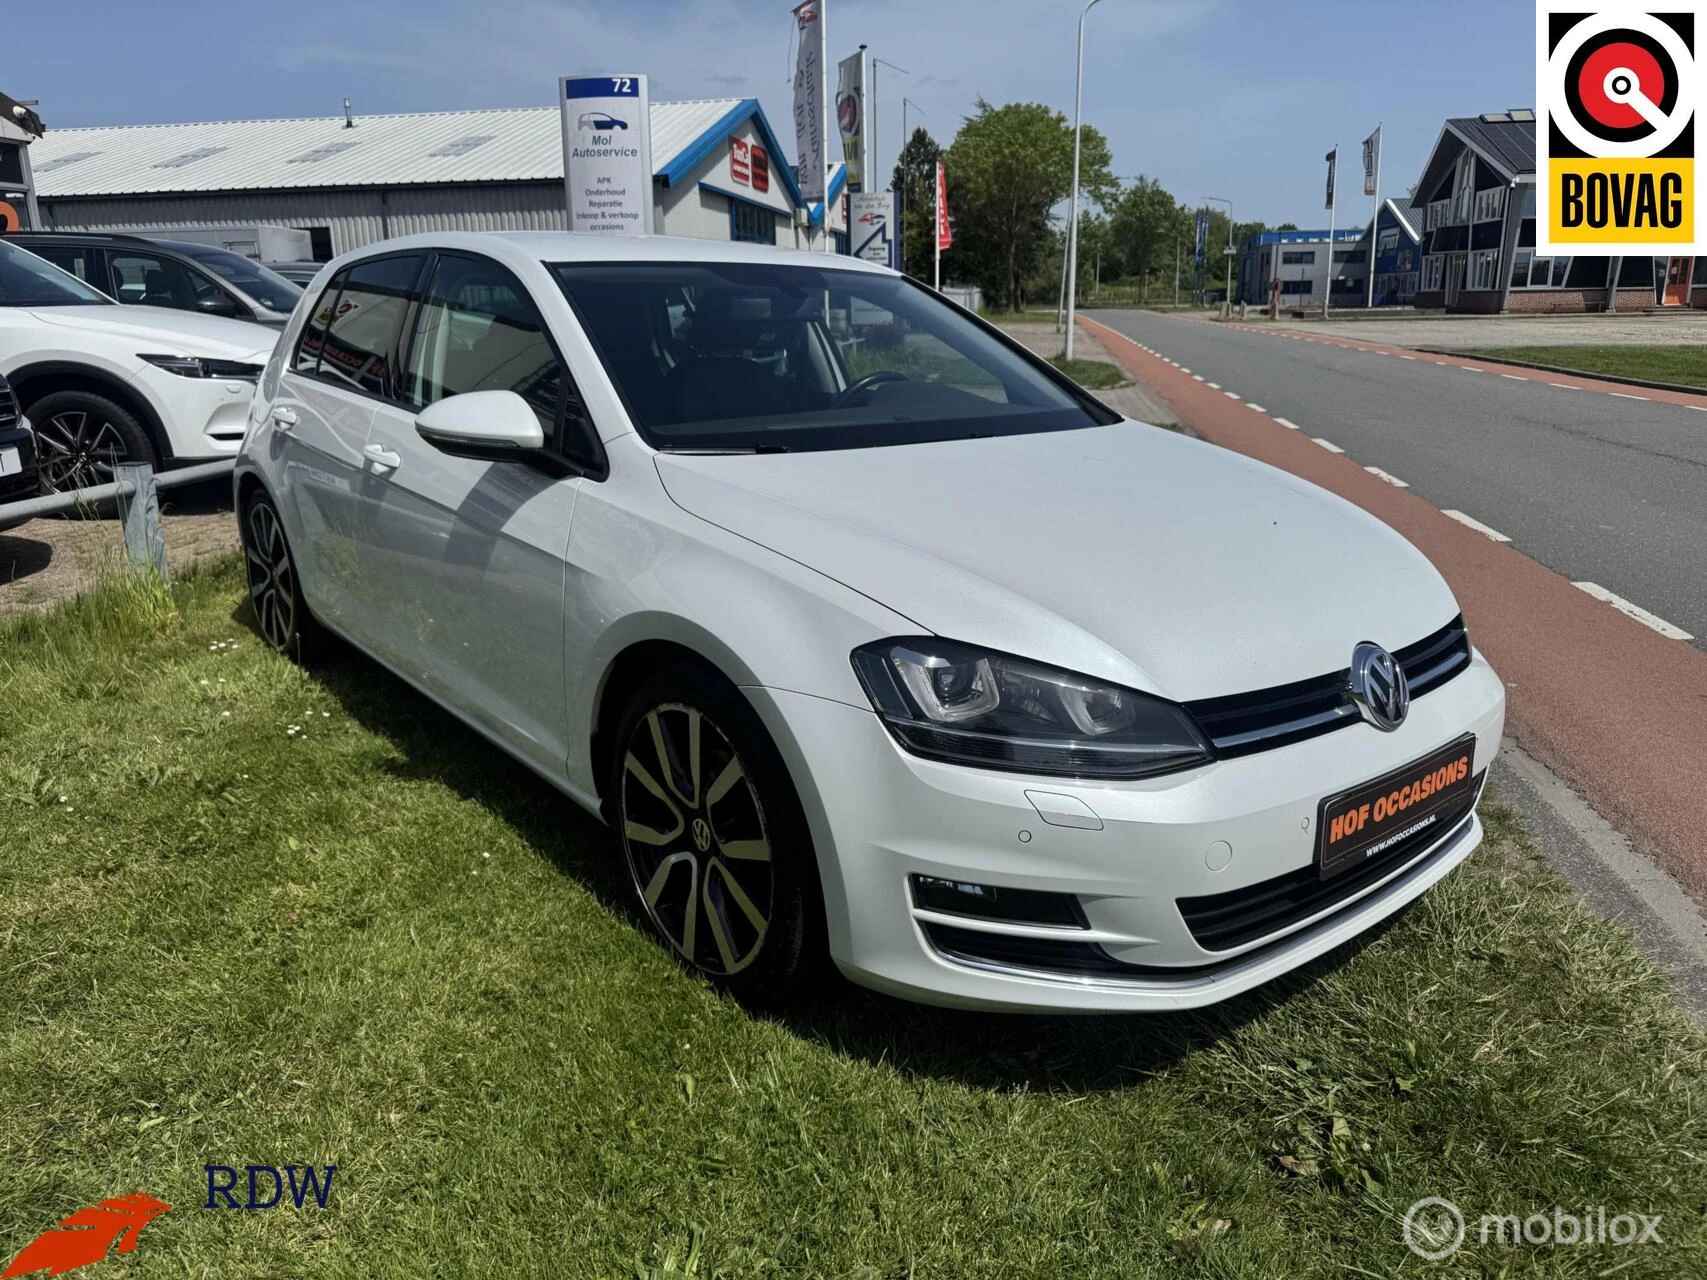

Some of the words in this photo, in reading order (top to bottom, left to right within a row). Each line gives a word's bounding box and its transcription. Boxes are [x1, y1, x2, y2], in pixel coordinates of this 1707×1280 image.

[611, 78, 631, 93] 72
[591, 135, 612, 146] Mol
[572, 146, 638, 158] Autoservice
[585, 188, 626, 196] Onderhoud
[588, 200, 623, 208] Reparatie
[601, 211, 607, 219] &
[608, 212, 639, 220] verkoop
[590, 223, 625, 231] occasions
[1329, 802, 1370, 843] HOF
[1373, 755, 1469, 822] OCCASIONS
[1365, 814, 1437, 857] WWW.HOFOCCASIONS.NL
